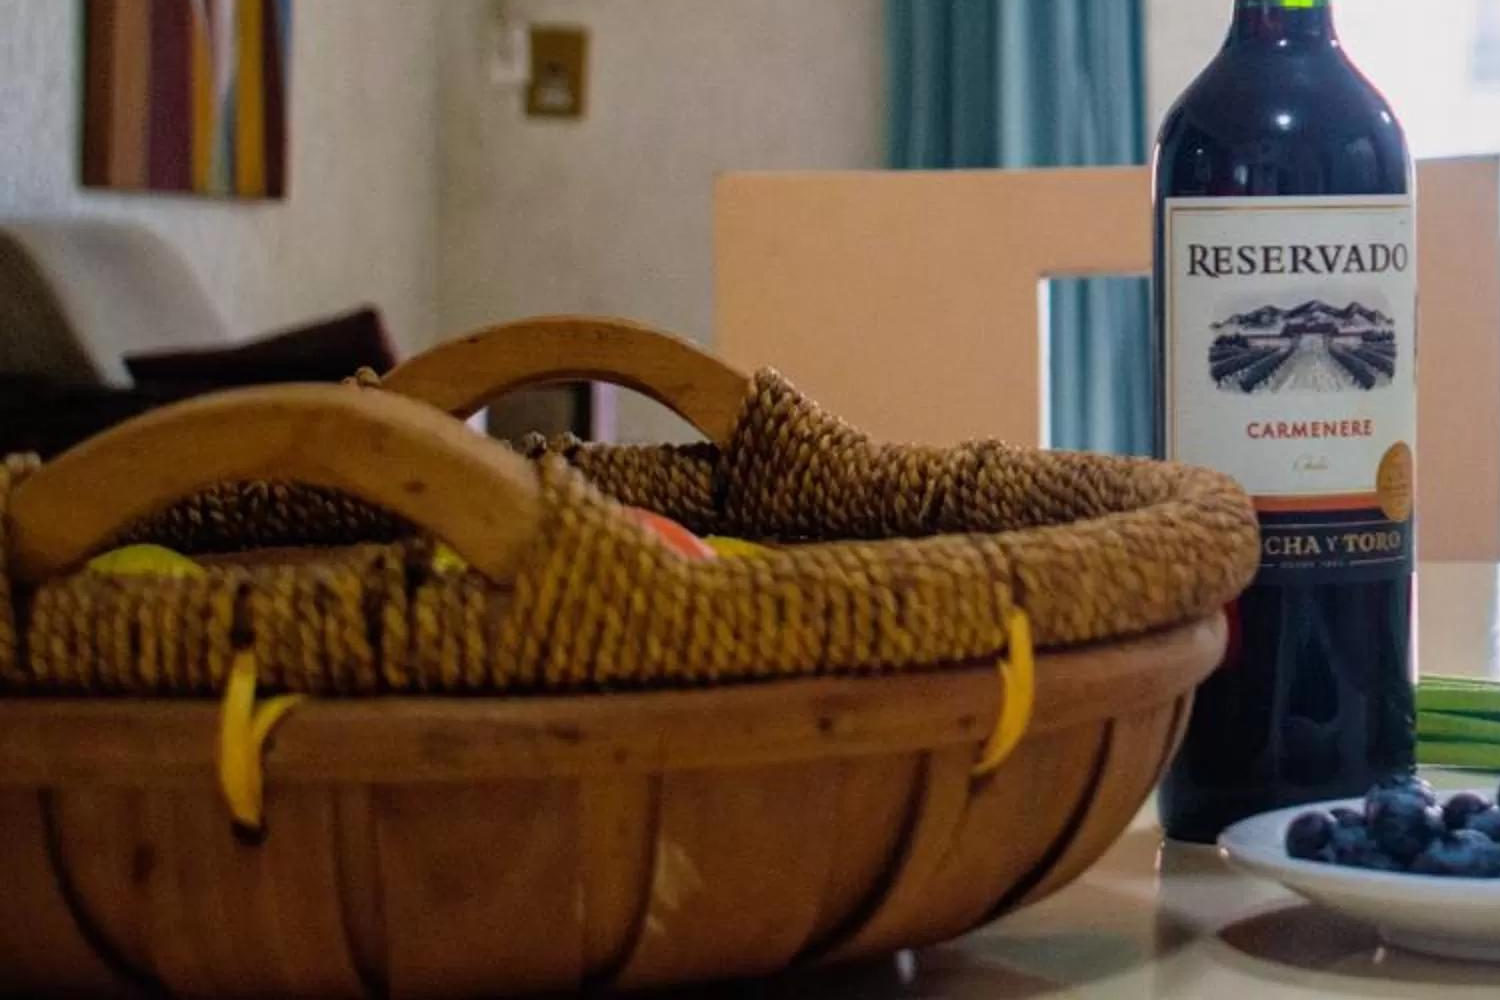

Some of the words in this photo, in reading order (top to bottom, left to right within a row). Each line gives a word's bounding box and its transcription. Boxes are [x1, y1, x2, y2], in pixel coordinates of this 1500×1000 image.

[1187, 243, 1408, 278] RESERVADO
[1247, 419, 1373, 438] CARMENERE
[1264, 535, 1321, 555] CHA
[1343, 531, 1401, 553] TORO
